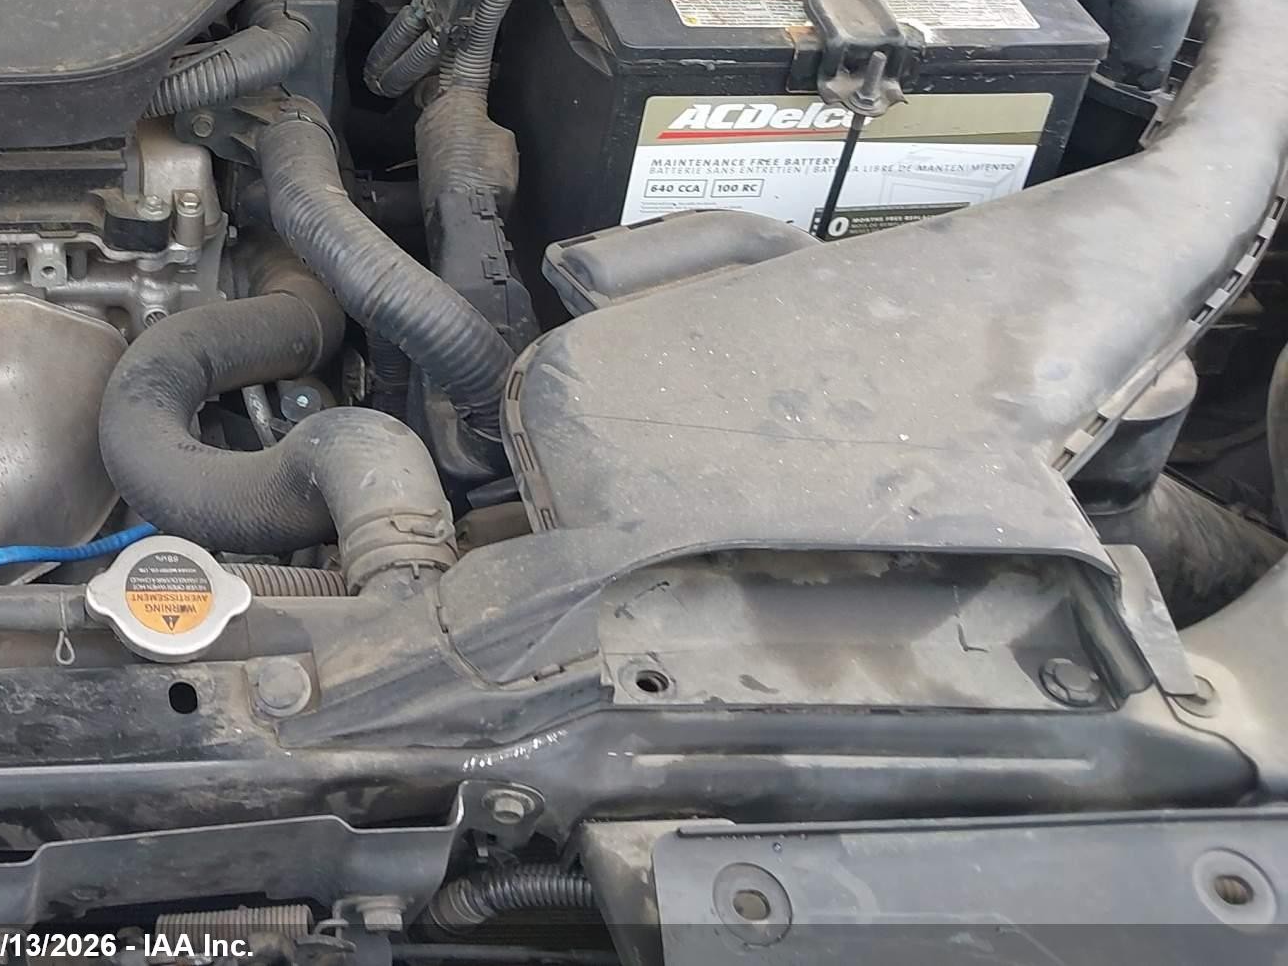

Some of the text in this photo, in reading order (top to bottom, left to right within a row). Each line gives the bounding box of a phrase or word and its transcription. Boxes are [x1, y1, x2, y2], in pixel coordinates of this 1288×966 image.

[650, 157, 839, 167] MAINTENANCE FREE BATTERY
[649, 167, 702, 175] BATTERIE
[707, 166, 735, 175] SANS
[738, 166, 802, 174] ENTRETIEN
[863, 164, 896, 173] LIBRE
[897, 164, 913, 172] DE
[650, 184, 701, 193] 640 CCA
[716, 183, 760, 193] 100 RC
[132, 593, 208, 602] AVERTISSEMENT
[144, 603, 197, 613] WARNING
